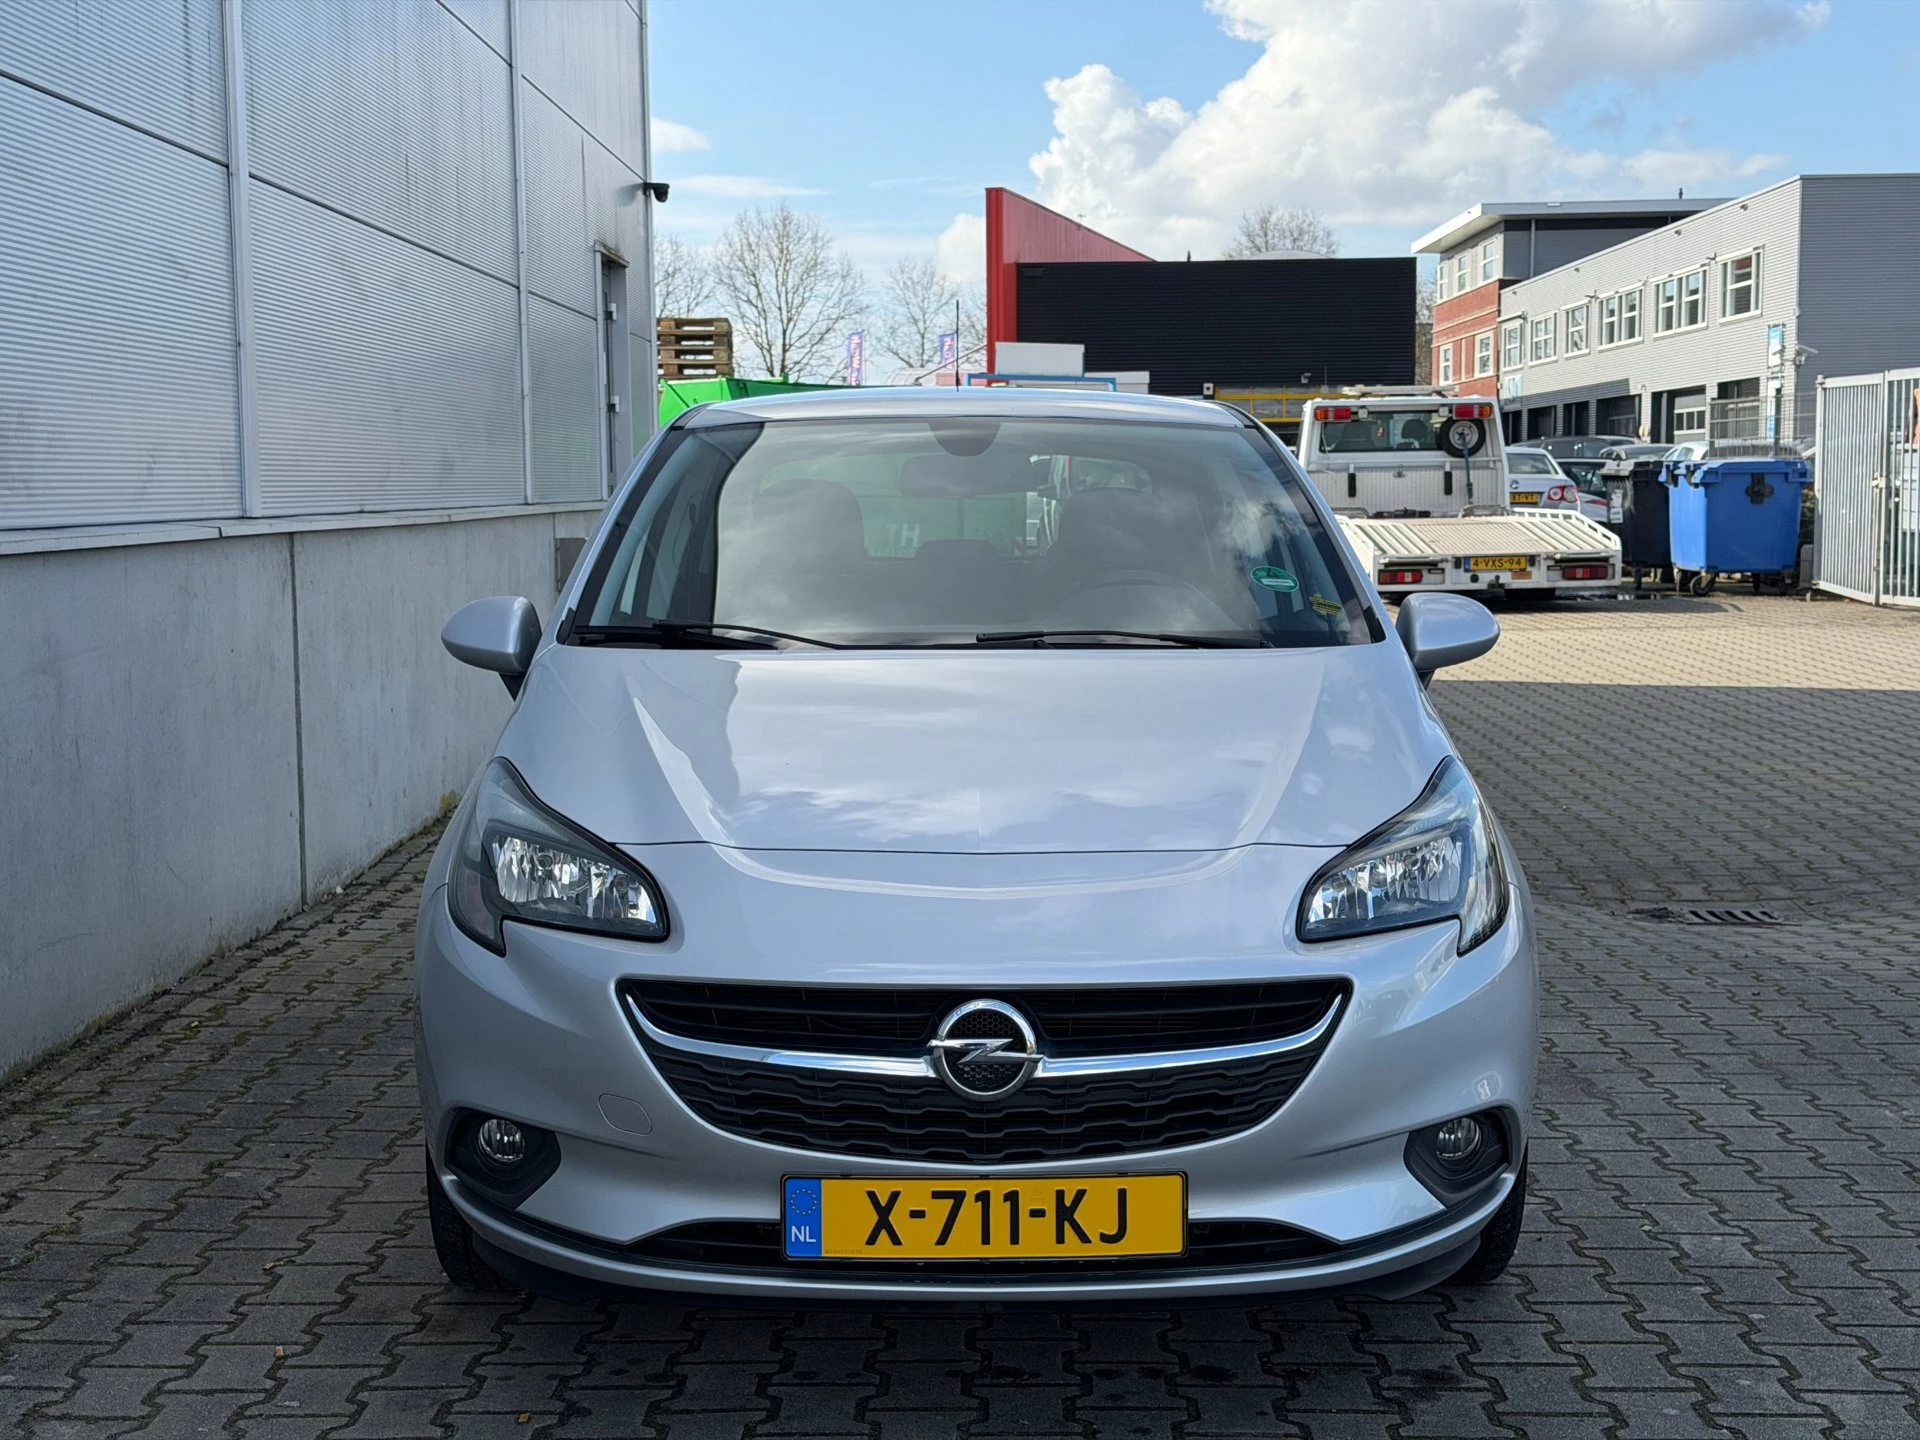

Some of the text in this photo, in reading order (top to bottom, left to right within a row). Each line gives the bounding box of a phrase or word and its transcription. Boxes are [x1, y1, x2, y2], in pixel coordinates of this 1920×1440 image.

[1473, 558, 1521, 568] 4-VXS-94
[864, 1188, 1128, 1246] X-711-KJ
[791, 1225, 816, 1243] NL
